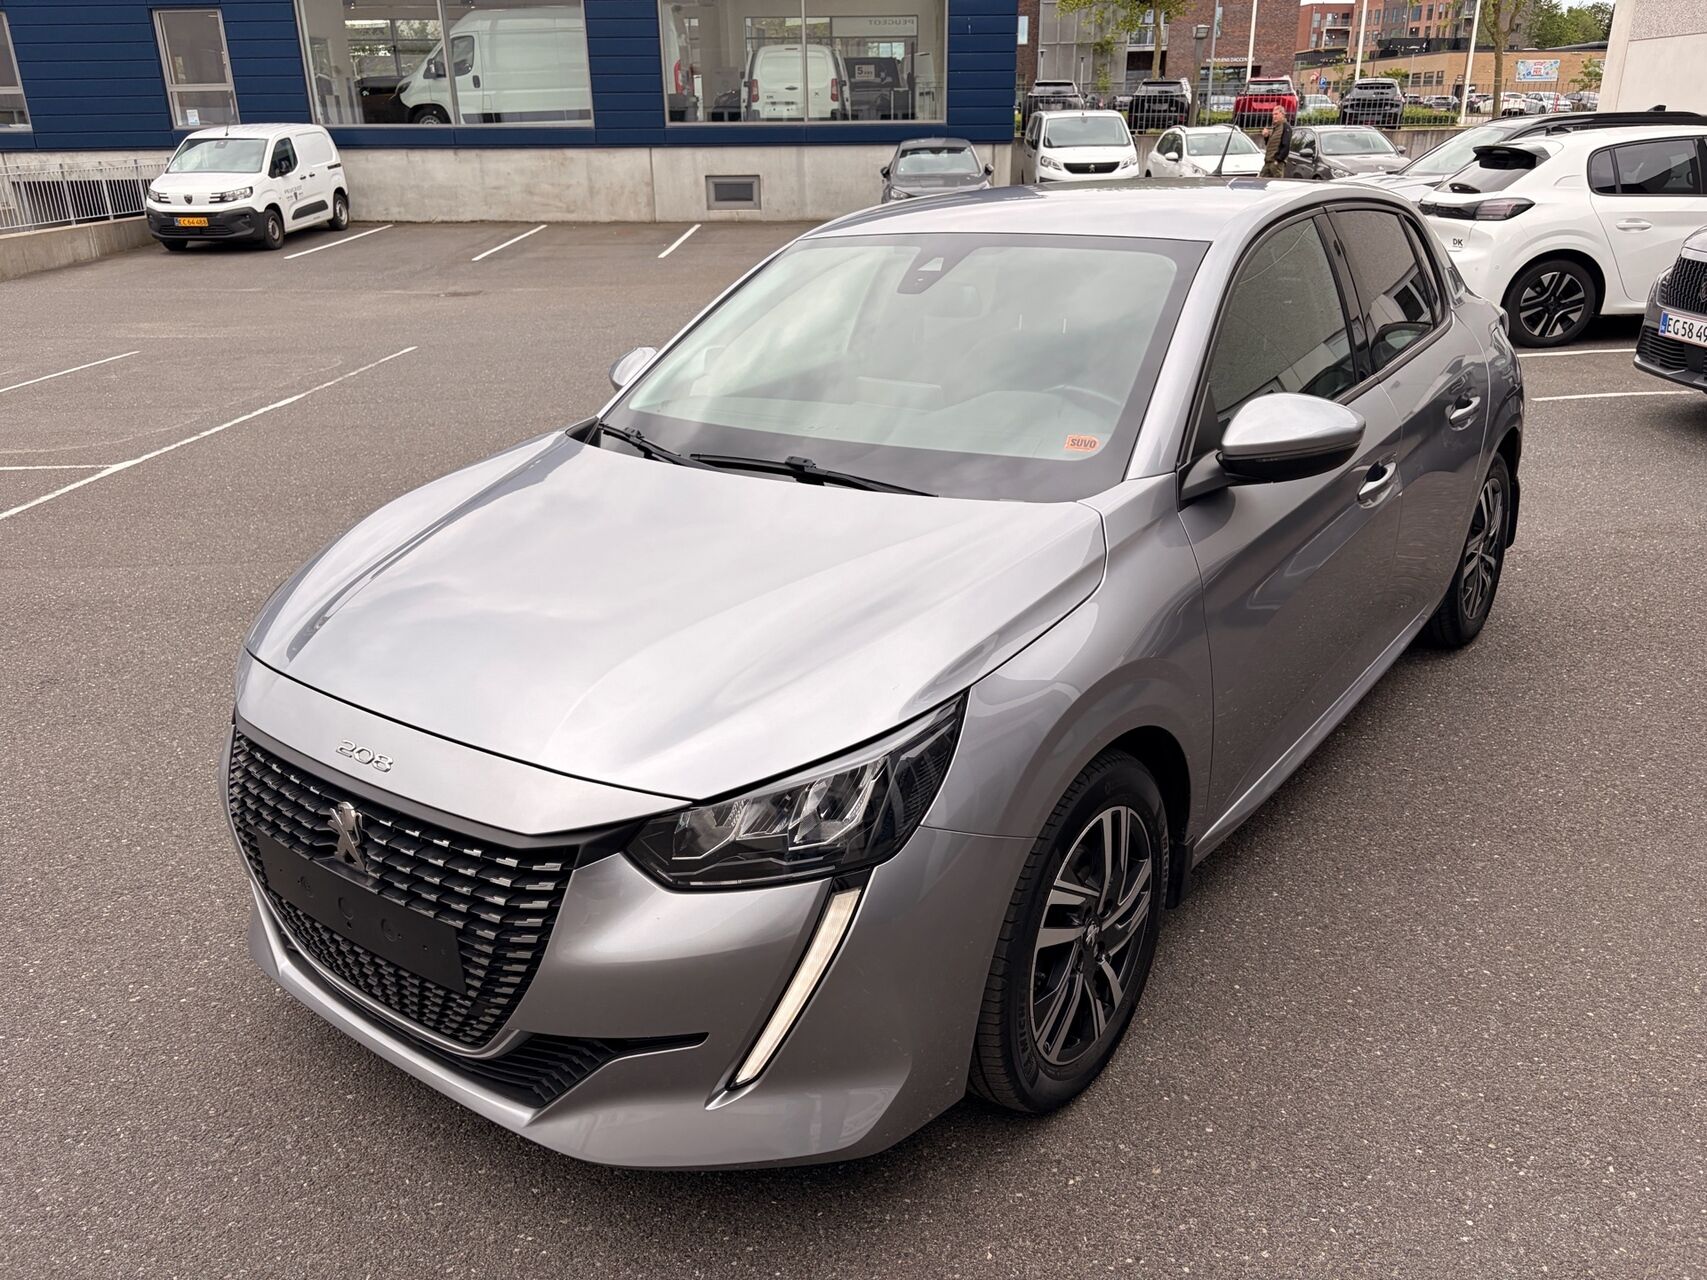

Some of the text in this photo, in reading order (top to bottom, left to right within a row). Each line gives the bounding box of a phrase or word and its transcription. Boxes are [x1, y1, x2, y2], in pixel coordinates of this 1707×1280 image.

[1452, 238, 1463, 246] DK
[1666, 317, 1680, 336] EG
[1681, 321, 1695, 339] 58
[1070, 438, 1097, 449] SUVO
[335, 739, 394, 773] 208
